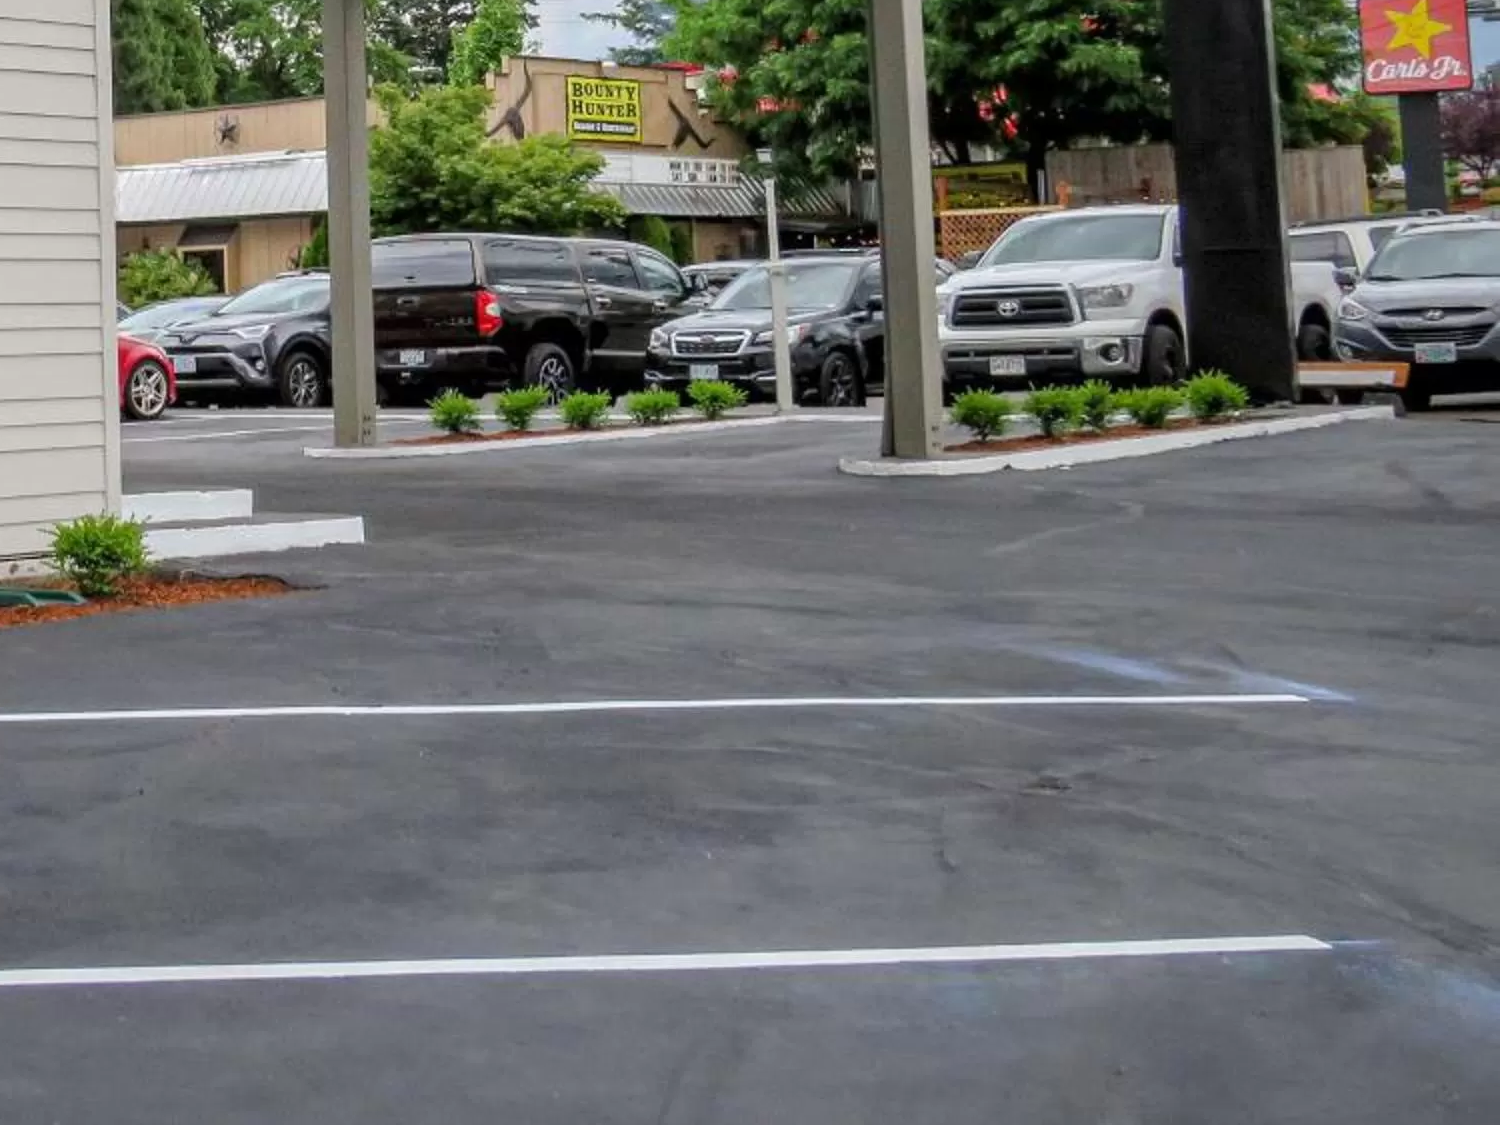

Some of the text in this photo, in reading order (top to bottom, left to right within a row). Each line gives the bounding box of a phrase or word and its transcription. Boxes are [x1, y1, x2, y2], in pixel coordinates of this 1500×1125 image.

[1428, 55, 1468, 81] Jr.
[571, 81, 636, 101] BOUNTY
[571, 99, 638, 118] HUNTER
